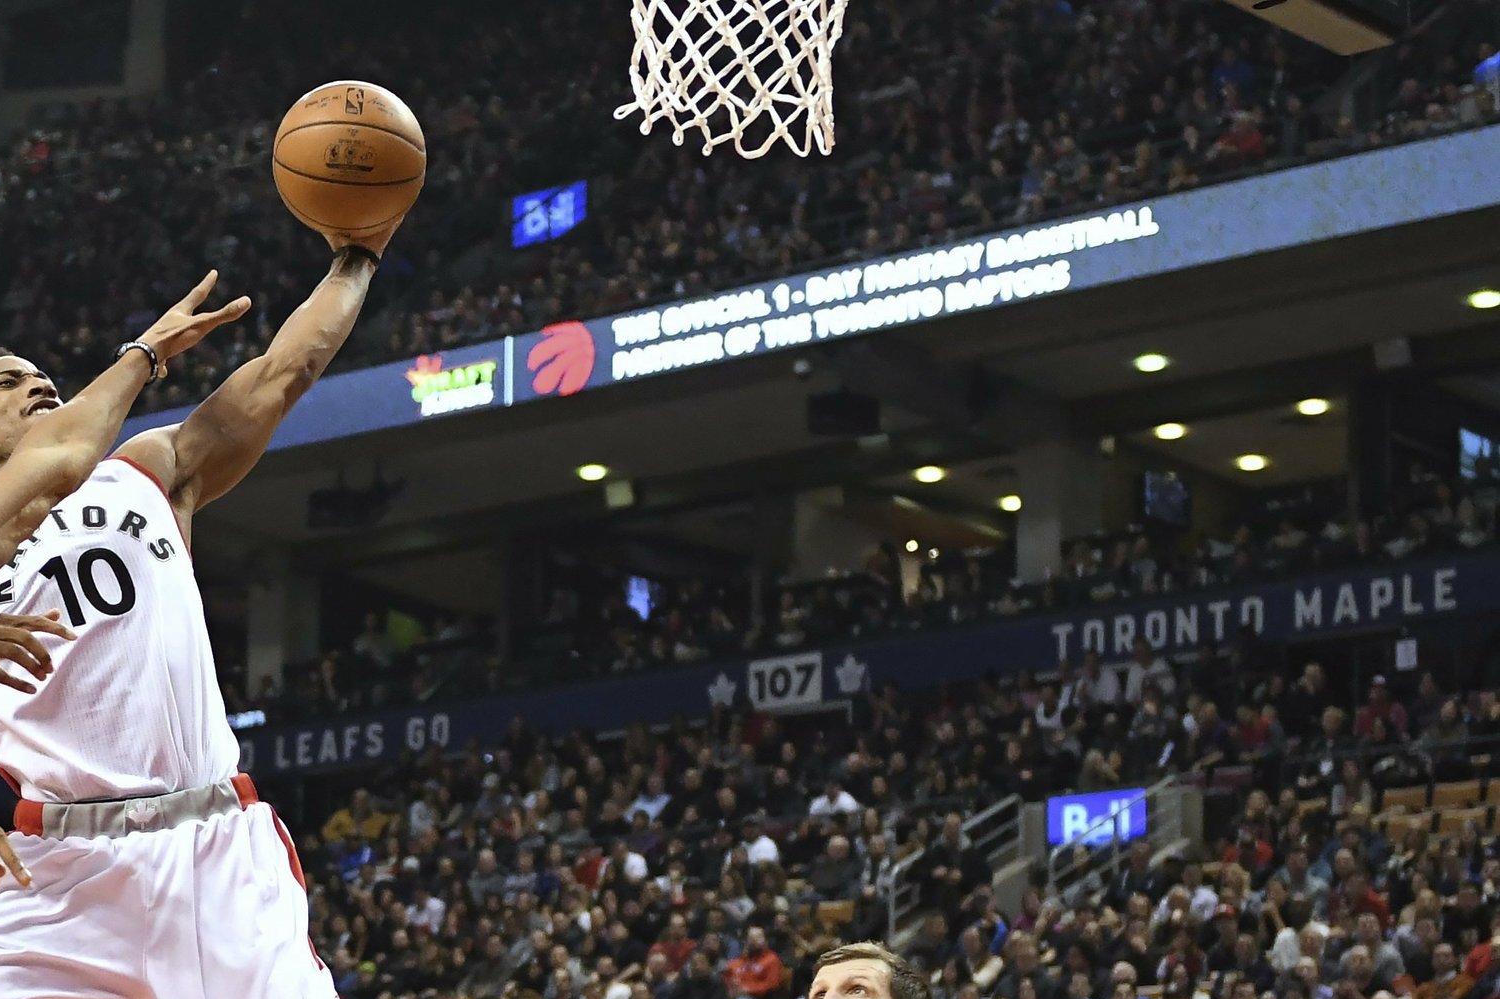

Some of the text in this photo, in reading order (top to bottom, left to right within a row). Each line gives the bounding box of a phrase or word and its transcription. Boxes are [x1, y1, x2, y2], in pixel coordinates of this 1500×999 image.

[39, 547, 136, 627] 10
[1052, 568, 1457, 663] TORONTO MAPLE
[755, 662, 816, 702] 107
[275, 722, 384, 769] LEAFS
[406, 712, 450, 752] GO
